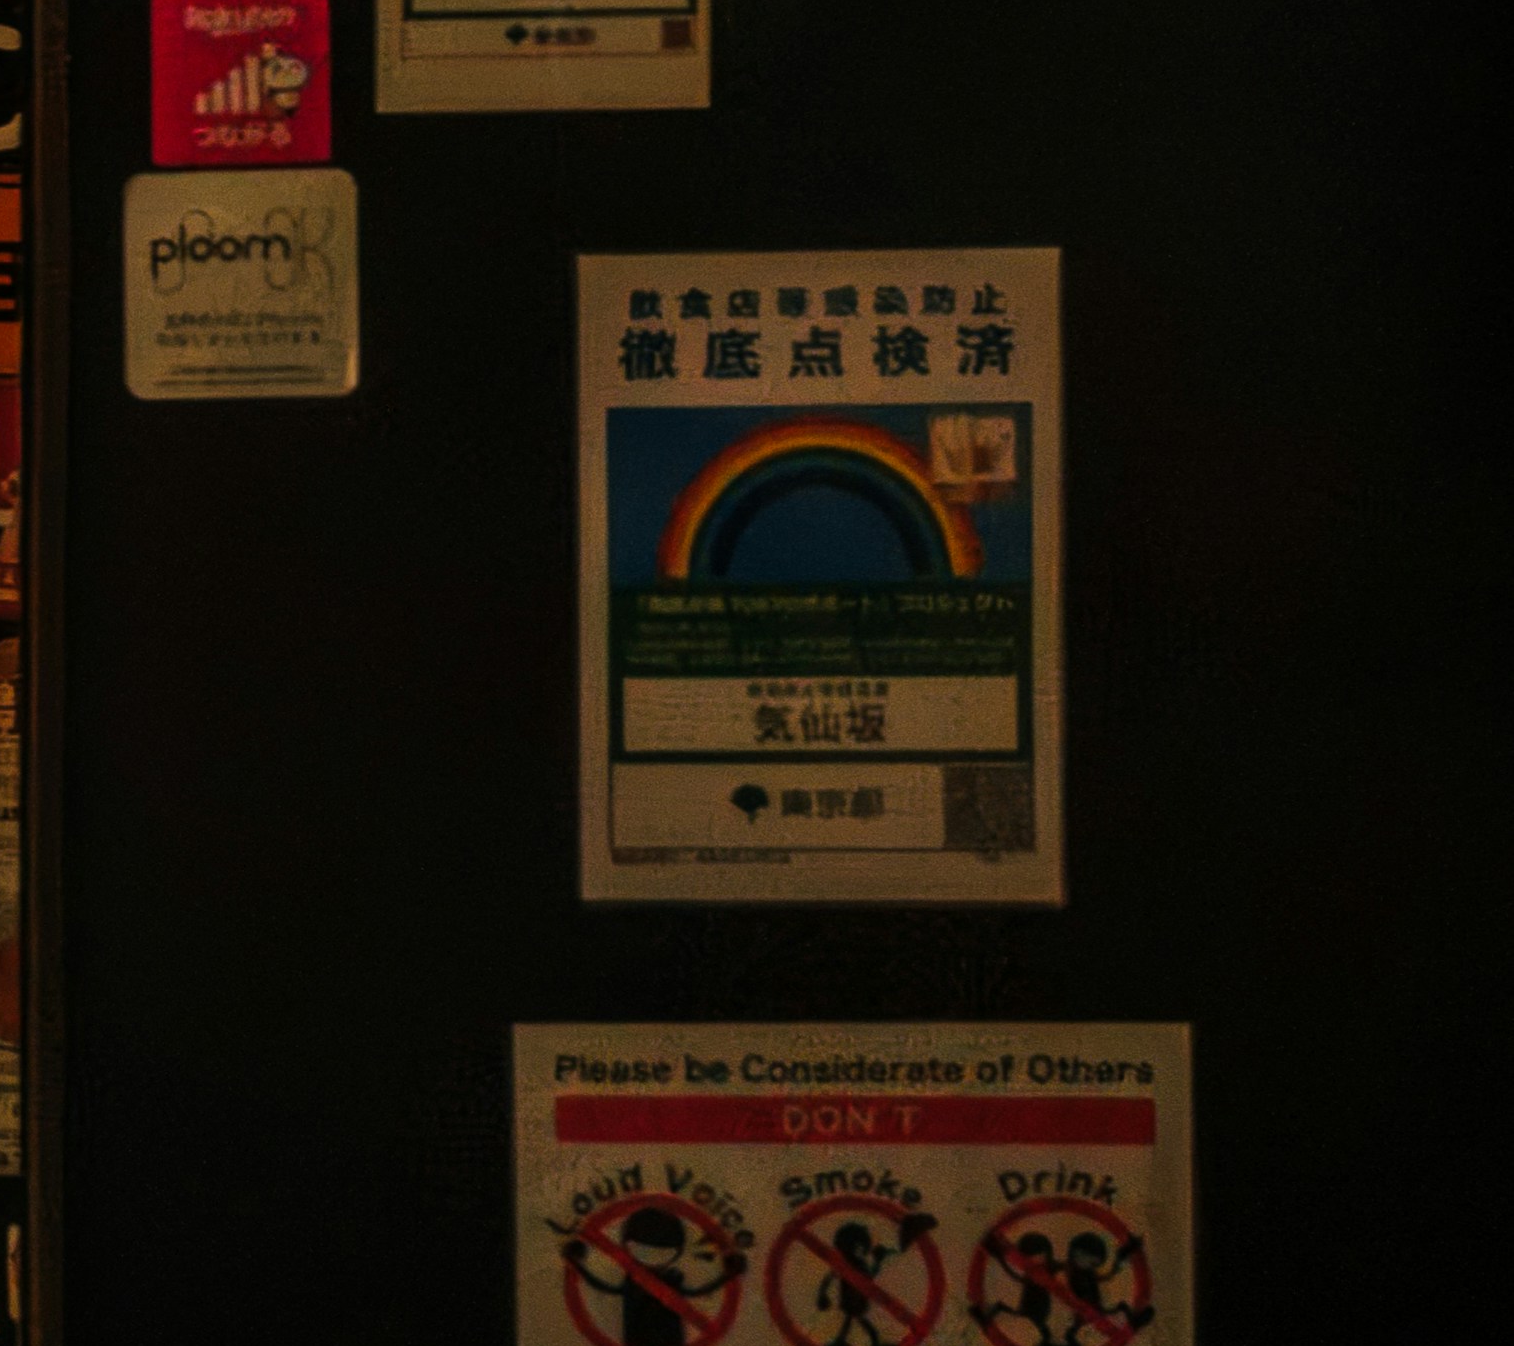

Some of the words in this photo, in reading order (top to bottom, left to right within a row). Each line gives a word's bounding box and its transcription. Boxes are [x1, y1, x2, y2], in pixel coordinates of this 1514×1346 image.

[618, 326, 1015, 381] 徹底点検済
[554, 1053, 671, 1085] Please
[685, 1053, 727, 1085] be
[743, 1052, 962, 1085] Considerate
[976, 1052, 1012, 1085] of
[1027, 1052, 1153, 1085] Others
[547, 1167, 644, 1238] Loud
[779, 1167, 922, 1211] Smoke
[996, 1163, 1121, 1206] Drink
